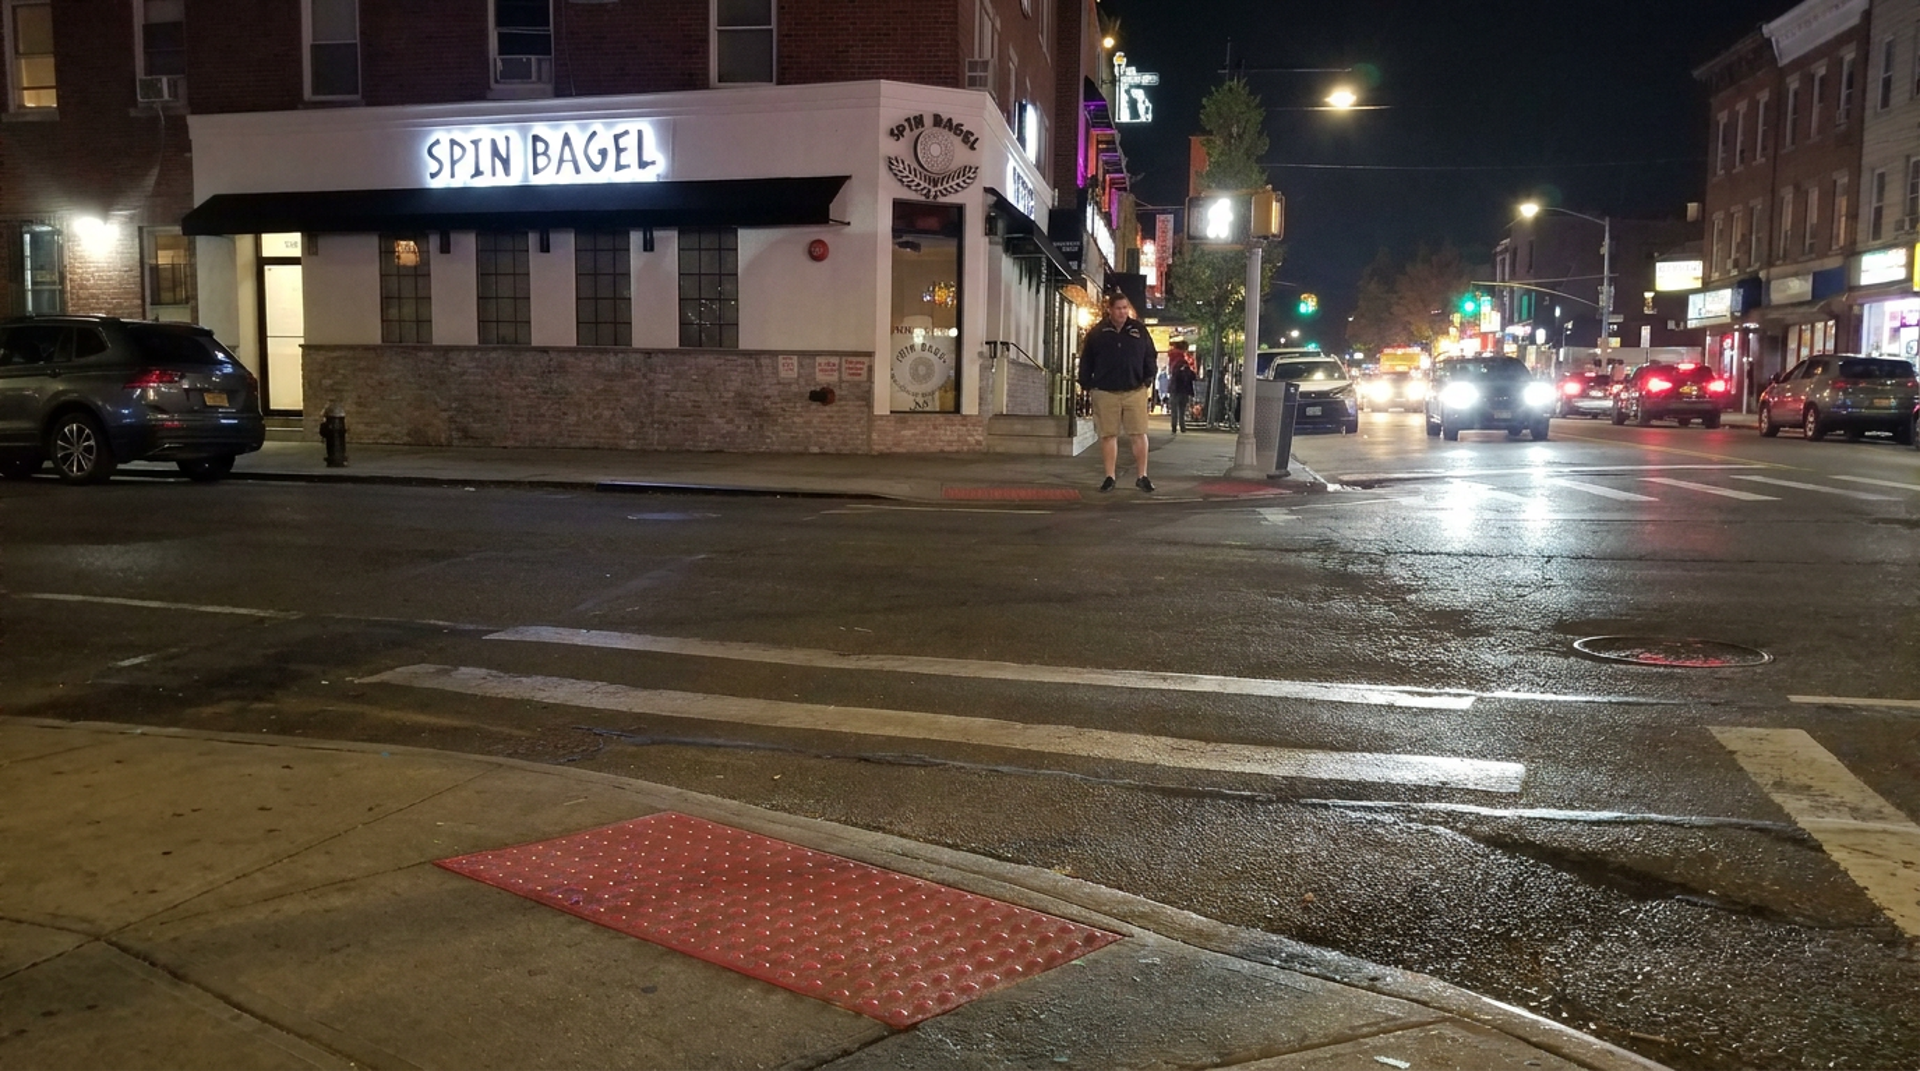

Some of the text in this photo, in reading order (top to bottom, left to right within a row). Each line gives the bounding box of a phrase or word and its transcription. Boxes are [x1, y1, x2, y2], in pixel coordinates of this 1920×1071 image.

[889, 113, 980, 151] SPIN BAGEL
[426, 129, 656, 180] SPIN BAGEL
